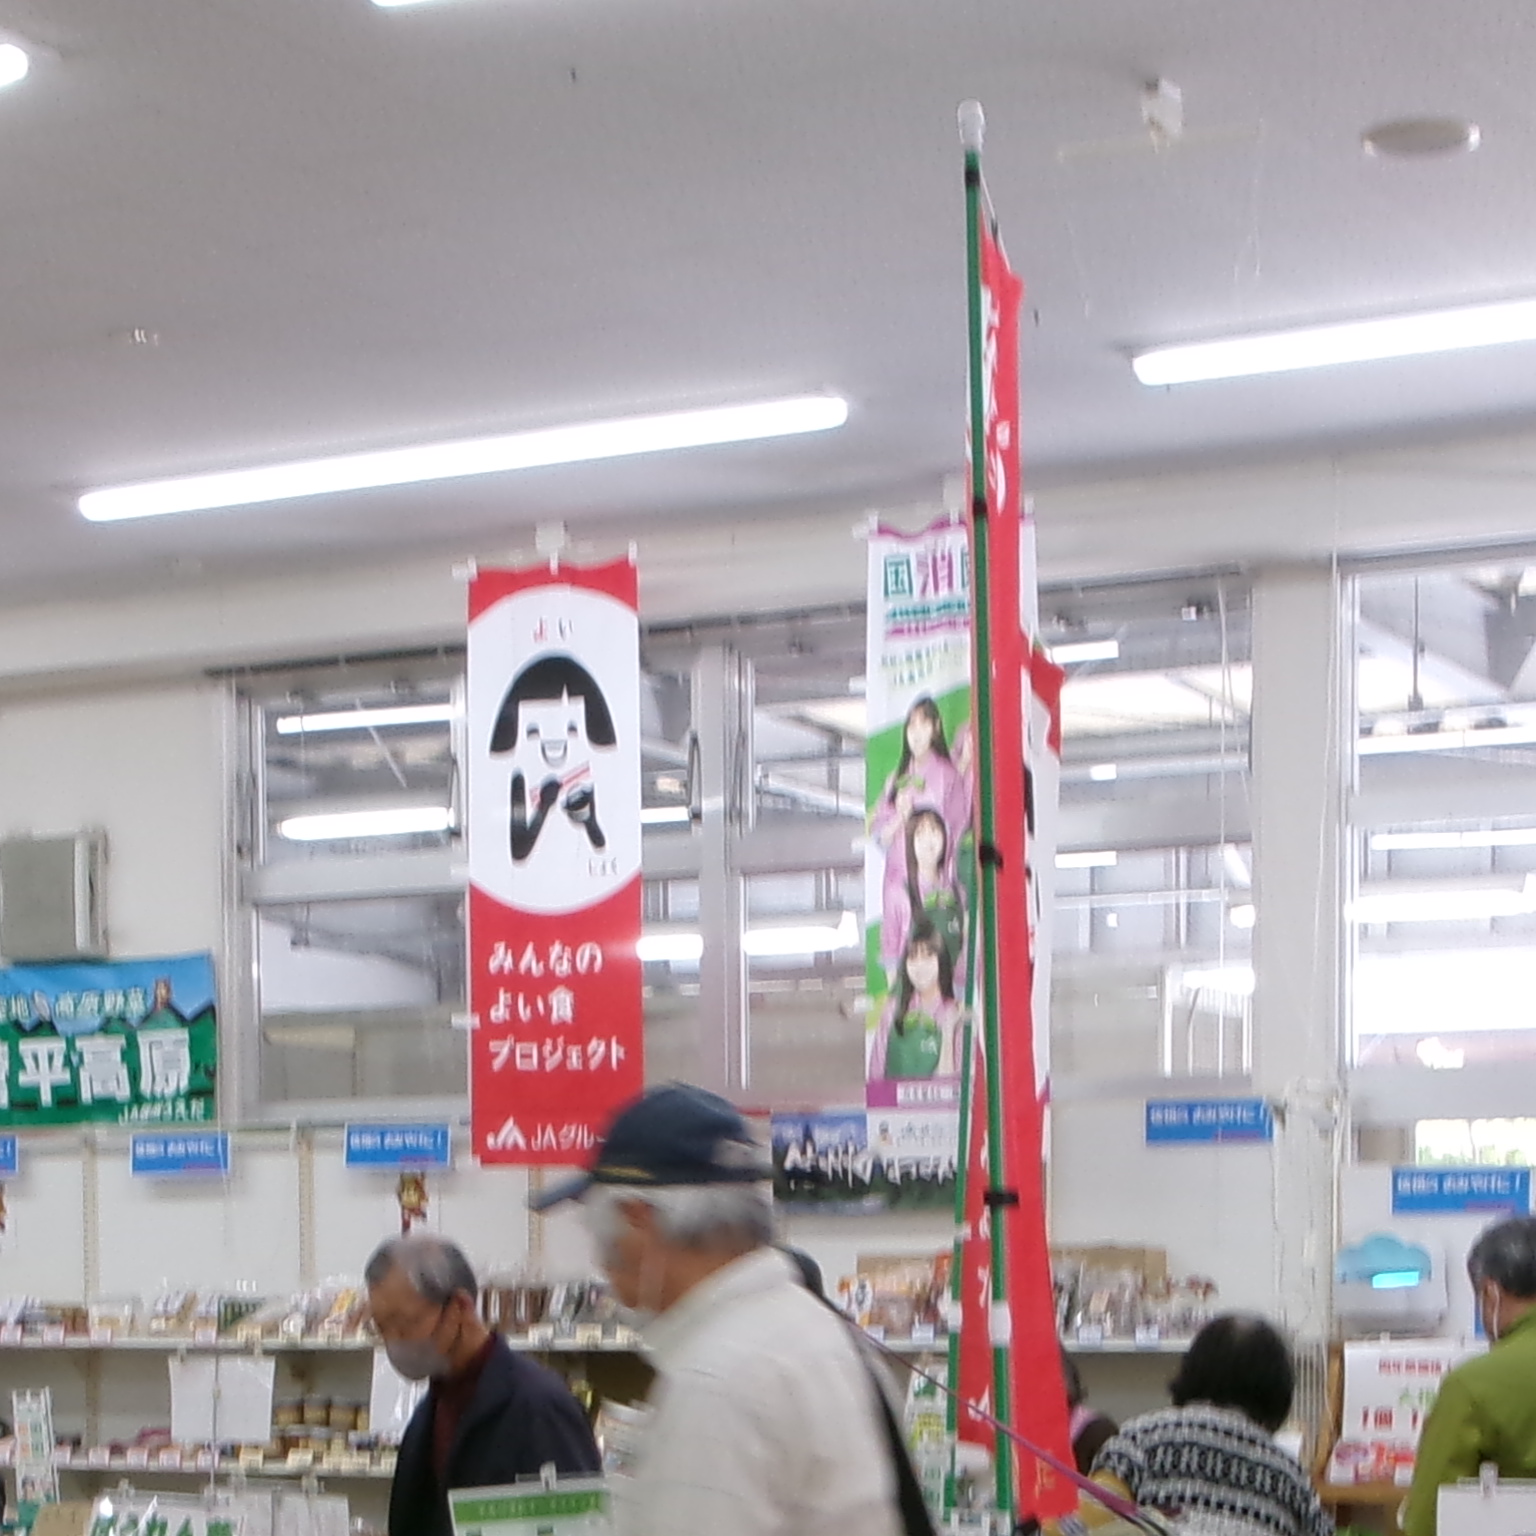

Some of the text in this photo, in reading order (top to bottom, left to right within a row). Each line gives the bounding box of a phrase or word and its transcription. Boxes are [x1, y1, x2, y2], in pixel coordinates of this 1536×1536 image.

[882, 545, 970, 598] 国消
[488, 940, 604, 976] みんなの
[489, 984, 577, 1025] よい食
[488, 1034, 626, 1074] プロジェクト
